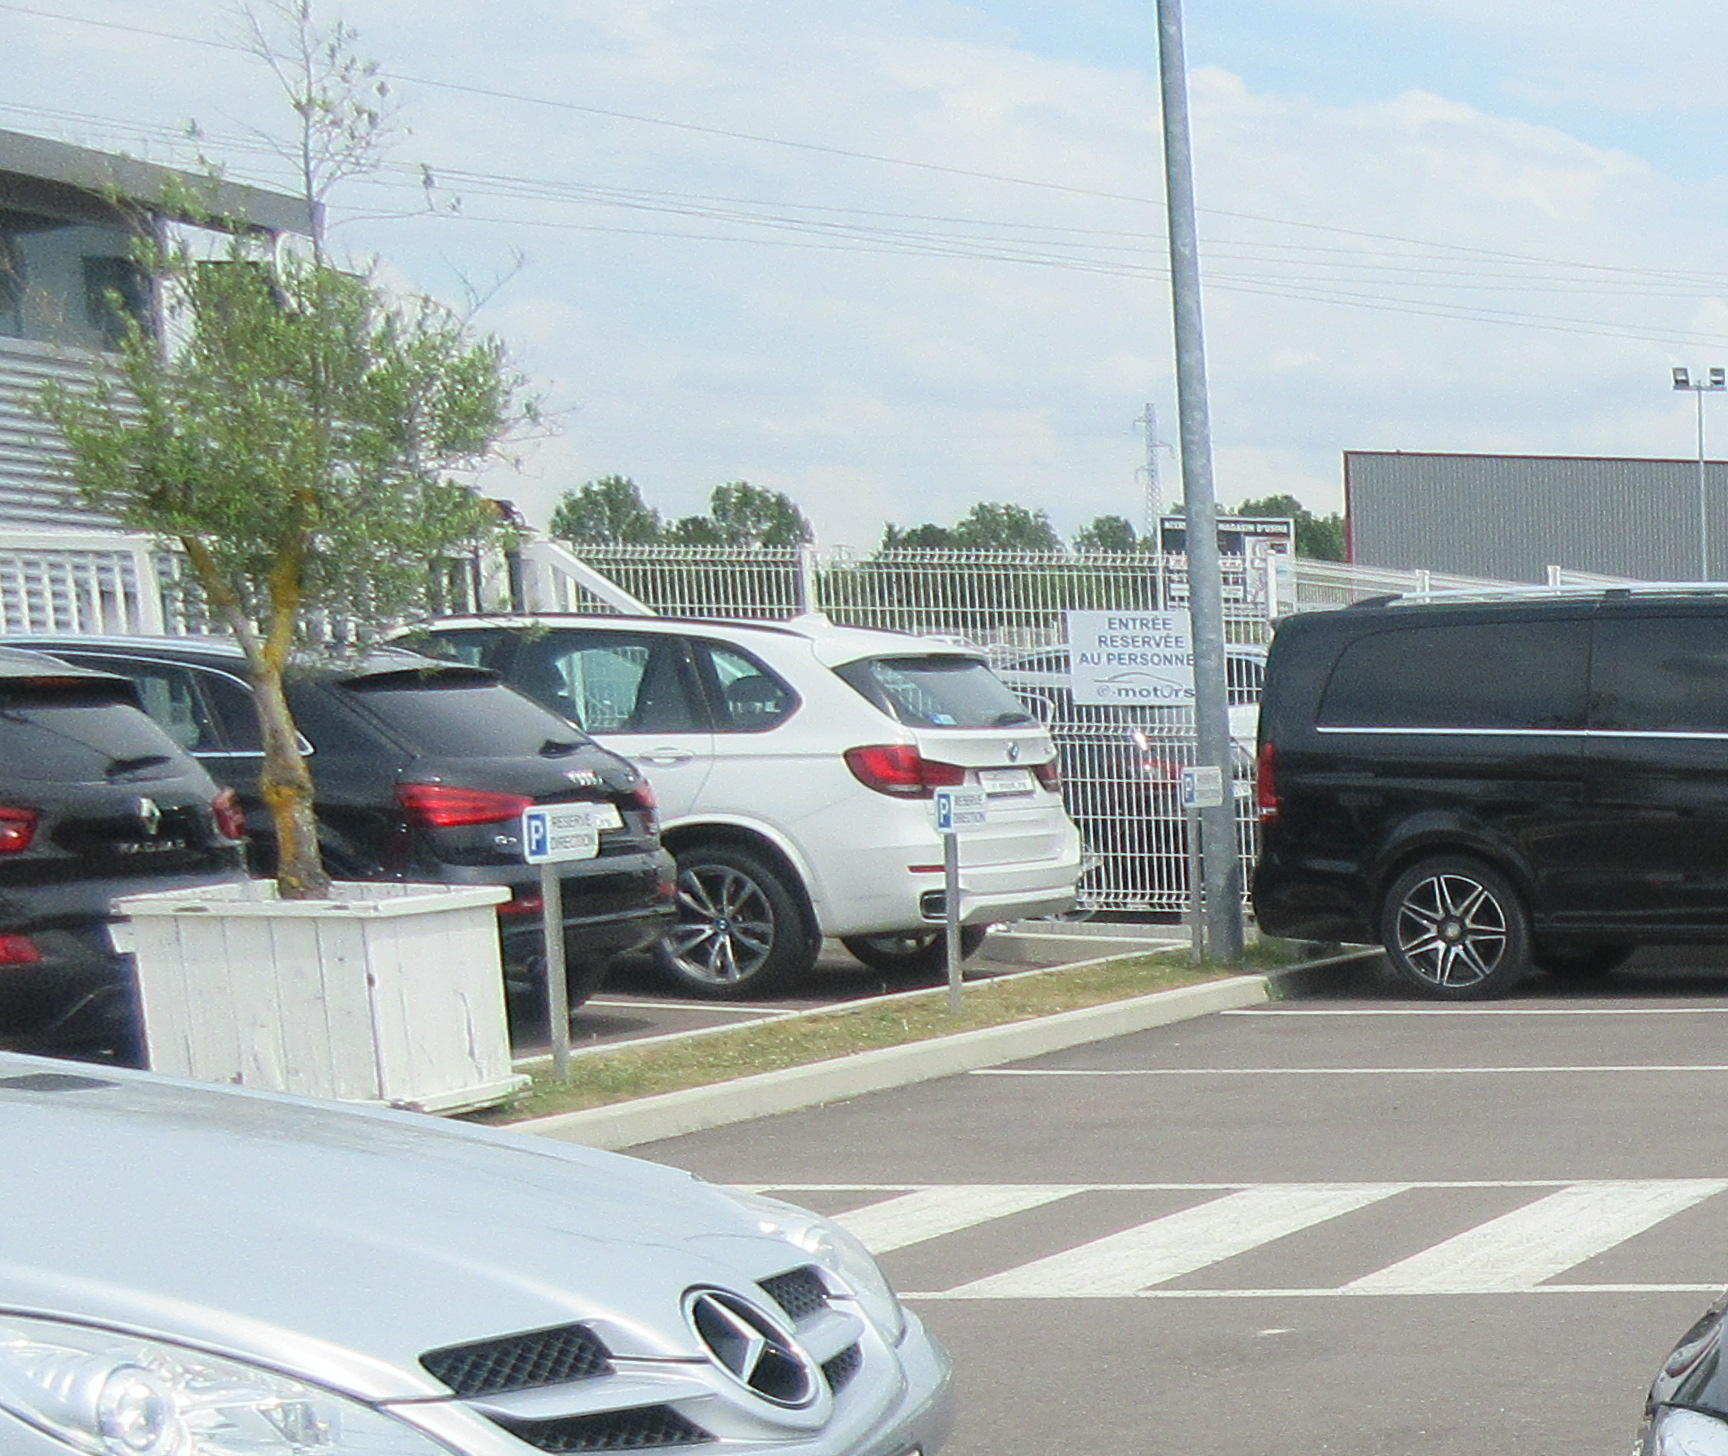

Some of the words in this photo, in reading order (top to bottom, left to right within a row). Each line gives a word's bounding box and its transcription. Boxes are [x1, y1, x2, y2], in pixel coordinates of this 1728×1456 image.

[1107, 616, 1173, 631] ENTRÉE
[1098, 633, 1186, 649] RESERVÉE
[1080, 653, 1102, 666] AU
[1107, 653, 1196, 666] PERSONNE
[530, 819, 545, 851] P
